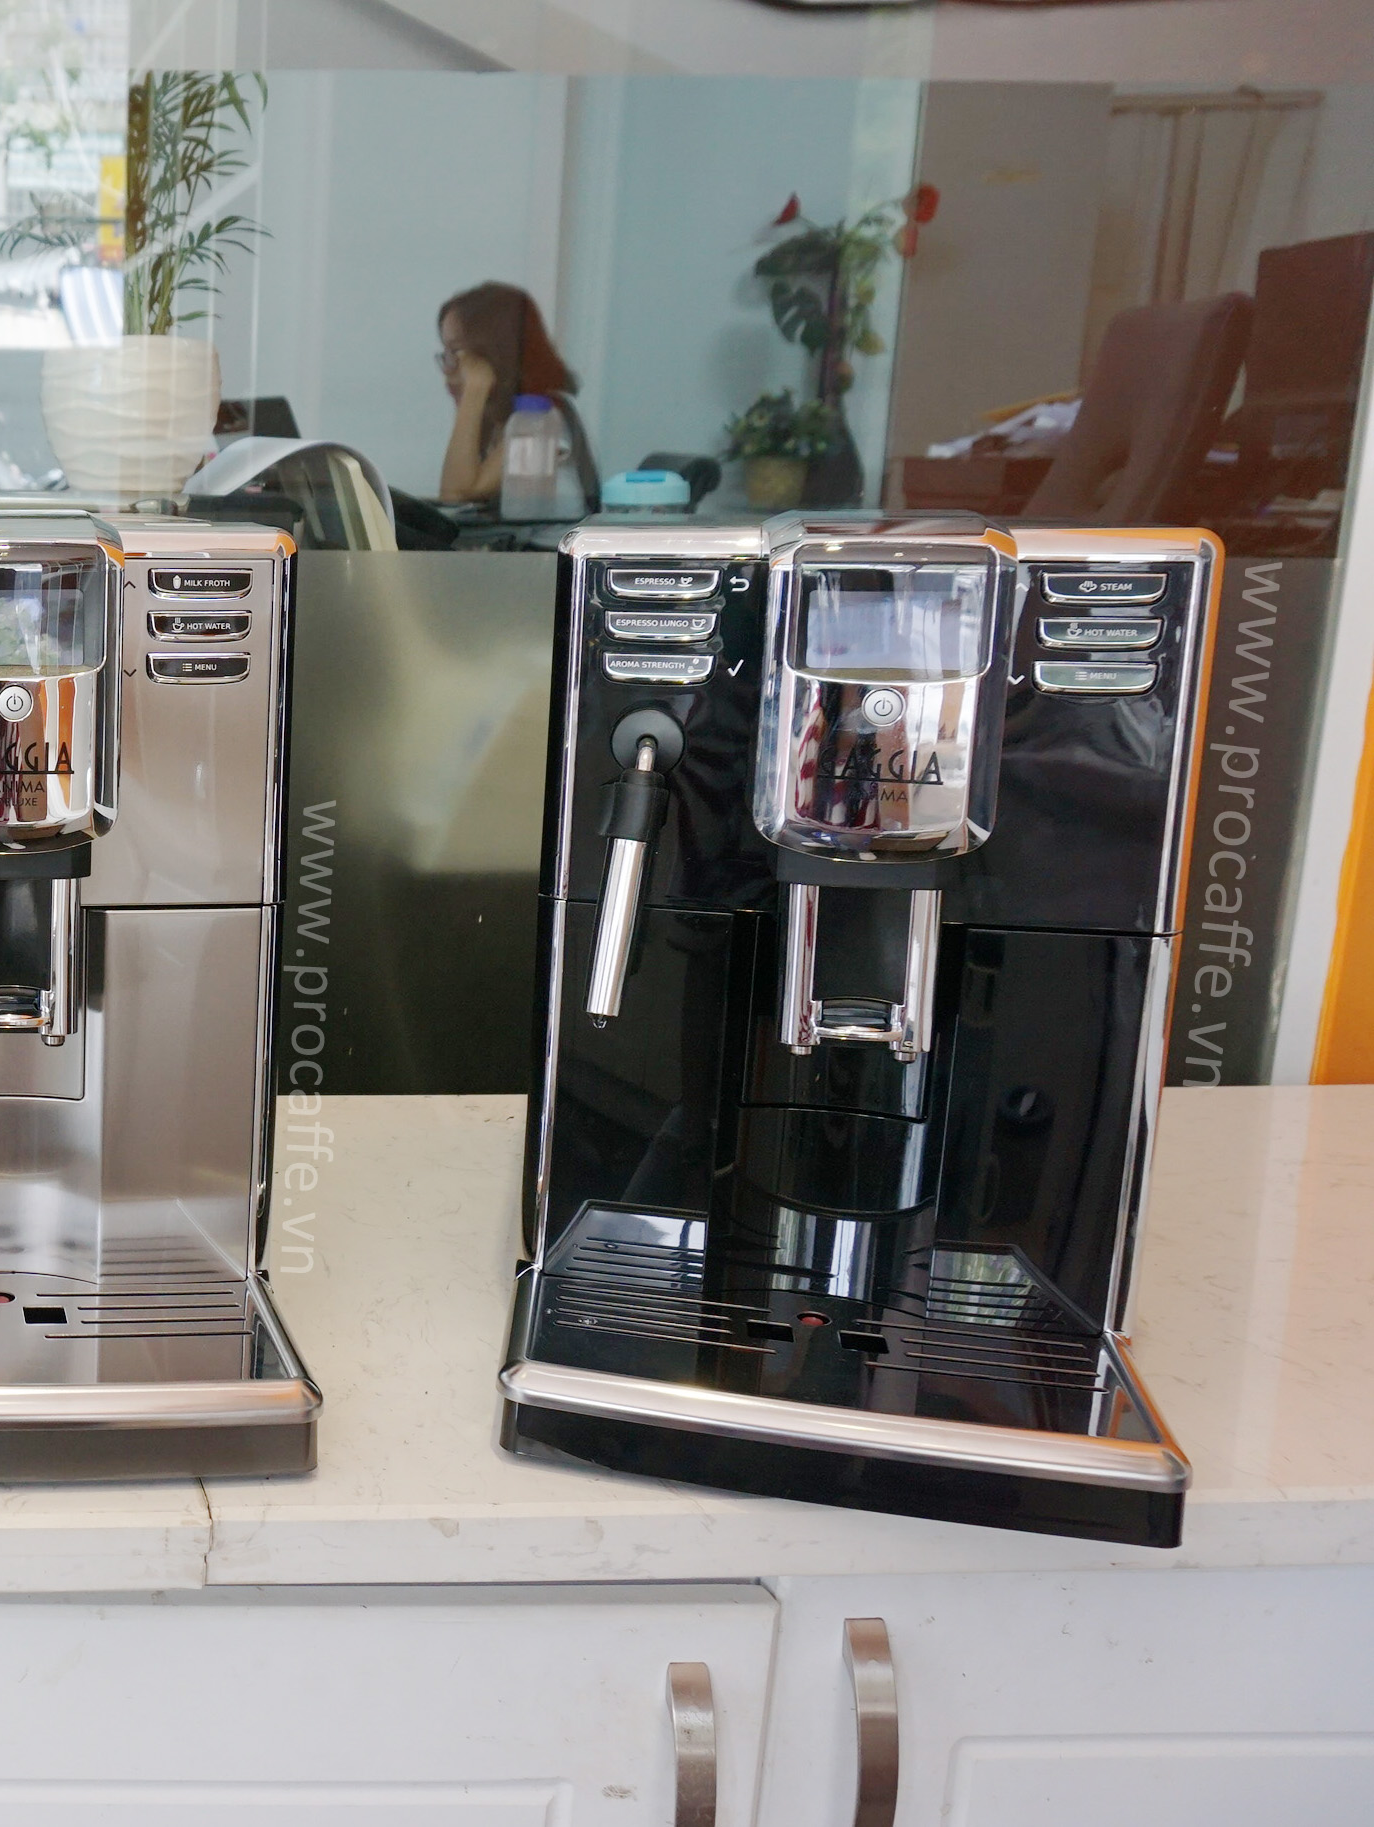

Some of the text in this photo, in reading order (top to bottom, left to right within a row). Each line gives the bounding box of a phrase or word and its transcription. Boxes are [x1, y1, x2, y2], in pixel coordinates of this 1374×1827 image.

[183, 579, 231, 587] MILK FROTH
[634, 577, 676, 585] ESPRESSO
[1100, 583, 1133, 591] STEAM
[204, 622, 231, 630] WATER
[615, 619, 689, 628] ESPRESSO LUNGO
[1084, 629, 1138, 637] HOT WATER
[609, 660, 685, 669] AROMA STRENGTH
